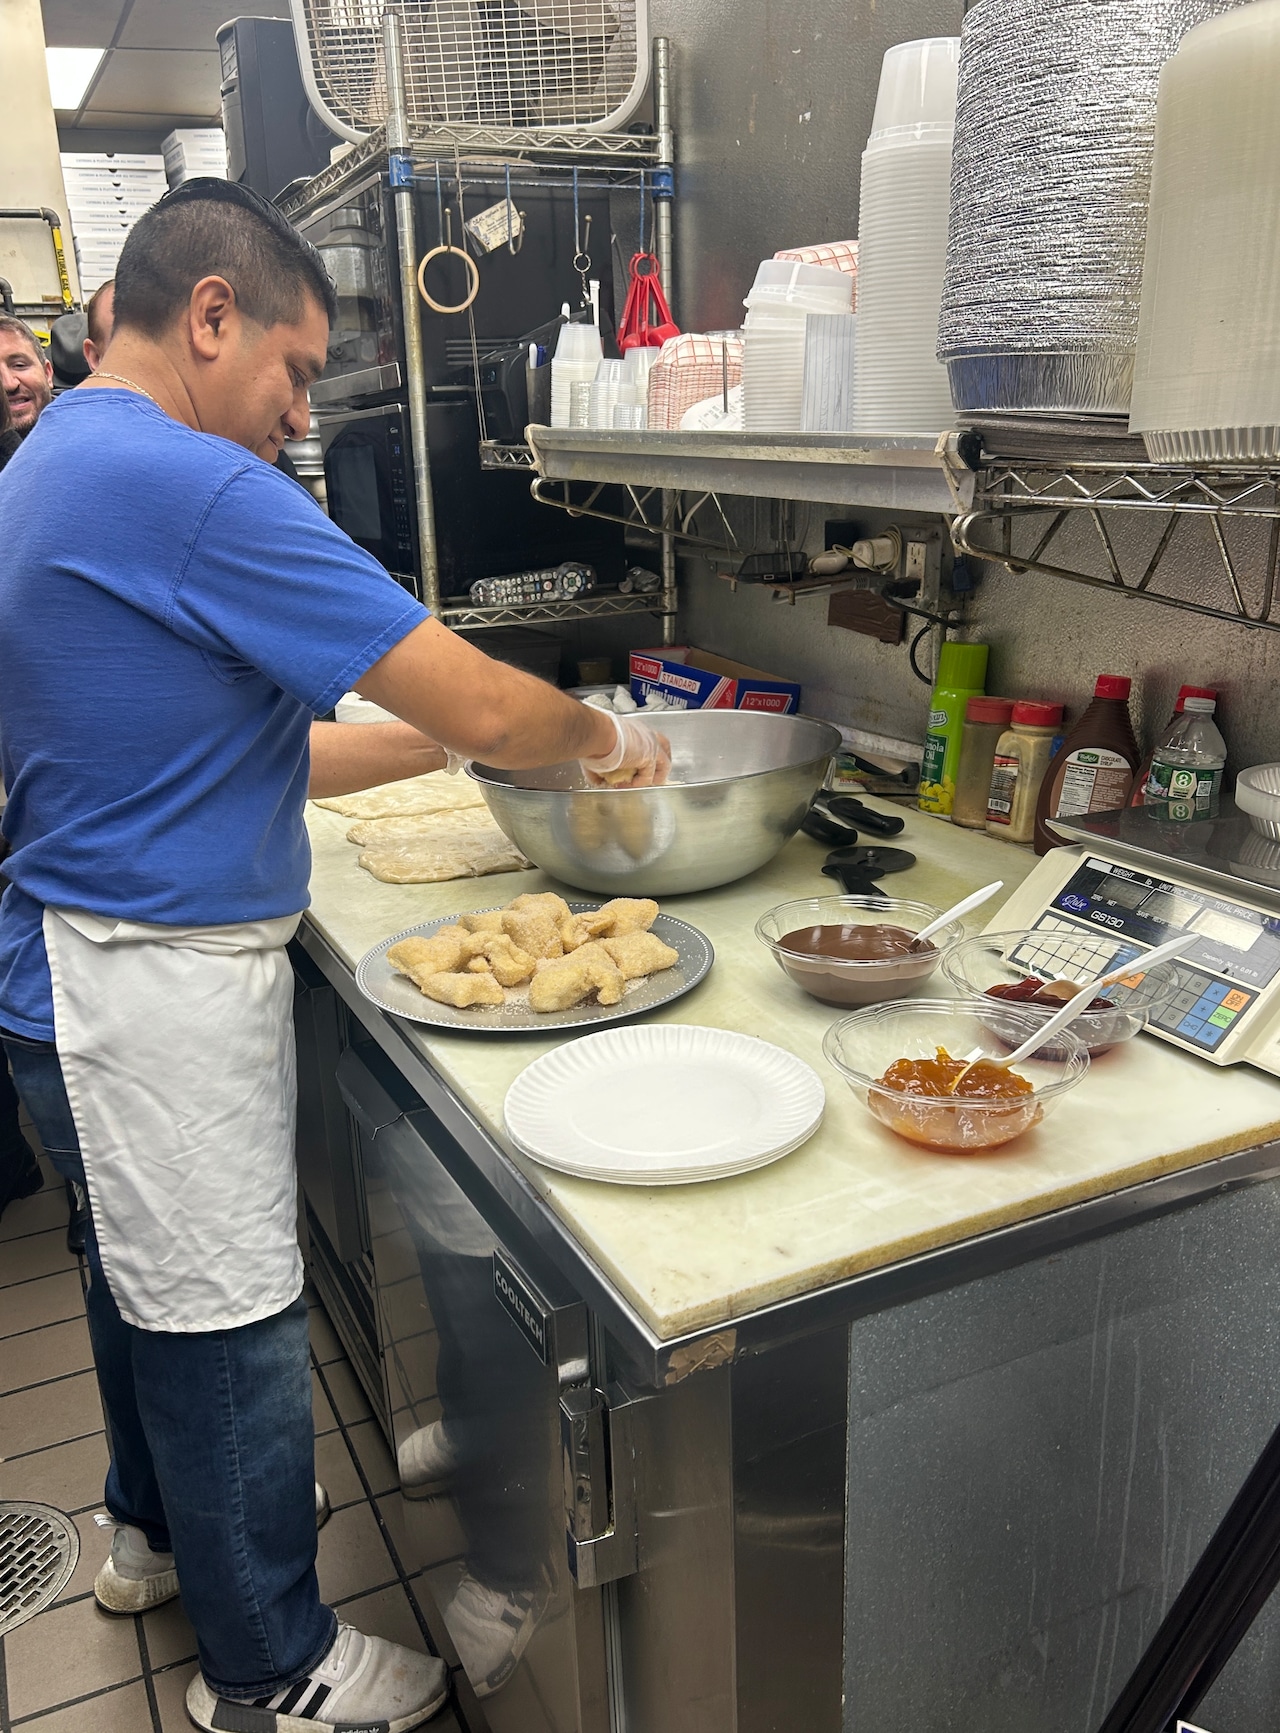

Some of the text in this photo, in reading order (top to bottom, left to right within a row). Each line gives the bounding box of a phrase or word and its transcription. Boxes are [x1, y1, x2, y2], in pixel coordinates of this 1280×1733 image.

[57, 248, 71, 291] NATURAL GAS
[661, 673, 697, 692] STANDARD
[745, 696, 781, 708] 12"x1000
[926, 740, 945, 753] anola
[925, 750, 935, 761] Oil
[1112, 867, 1153, 886] WEIGHT lb
[1158, 882, 1172, 892] UNIT
[1170, 886, 1188, 897] PRICE
[1062, 894, 1088, 911] Globe
[1106, 899, 1117, 907] NET
[1214, 901, 1233, 913] TOTAL
[1233, 907, 1254, 920] PRICE
[1090, 910, 1125, 929] GS130
[1201, 952, 1224, 965] Capacity
[1225, 999, 1241, 1008] OFF
[1232, 993, 1244, 1002] ON
[1213, 1011, 1232, 1023] ZERO
[1183, 1021, 1199, 1031] CHG
[495, 1270, 543, 1344] COOLTECH
